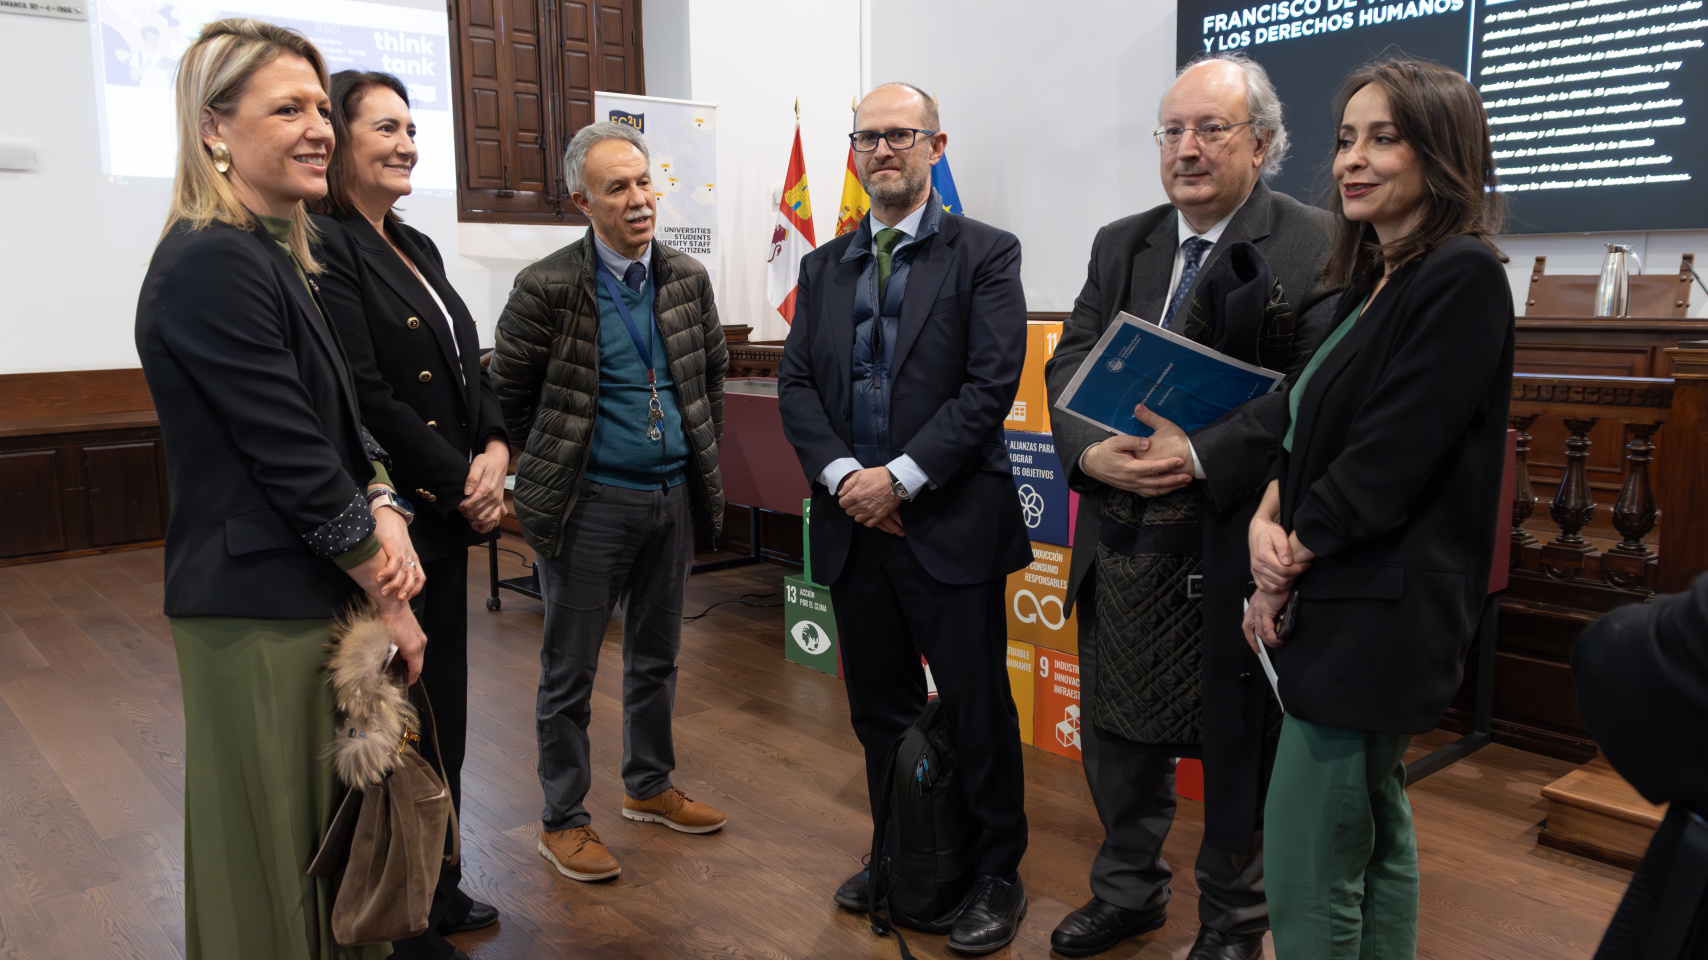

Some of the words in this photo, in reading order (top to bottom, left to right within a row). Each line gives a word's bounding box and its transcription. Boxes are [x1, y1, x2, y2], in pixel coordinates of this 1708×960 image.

[1203, 0, 1321, 35] FRANCISCO
[1203, 37, 1215, 53] Y
[1218, 31, 1250, 51] LOS
[1255, 11, 1354, 45] DERECHOS
[1359, 0, 1465, 27] HUMANOS
[374, 31, 435, 56] think
[382, 54, 436, 77] tank
[664, 226, 711, 234] UNIVERSITIES
[1046, 332, 1058, 355] 11
[1010, 440, 1038, 452] ALIANZAS
[1038, 443, 1055, 453] PARA
[1010, 453, 1033, 464] LOGRAR
[1012, 466, 1021, 476] OS
[1021, 467, 1054, 480] OBJETIVOS
[1032, 549, 1063, 562] ODUCCIÓN
[1030, 562, 1059, 575] CONSUMO
[1025, 573, 1067, 589] RESPONSABLES
[786, 584, 797, 604] 13
[800, 588, 815, 599] ACCIÓN
[800, 598, 808, 608] POR
[809, 600, 814, 609] EL
[814, 602, 828, 612] CLIMA
[1007, 646, 1030, 660] EQUIBLE
[1040, 656, 1049, 678] 9
[1054, 659, 1080, 674] INDUSTR
[1054, 672, 1080, 687] INNOVAC
[1053, 684, 1080, 700] INFRAEST
